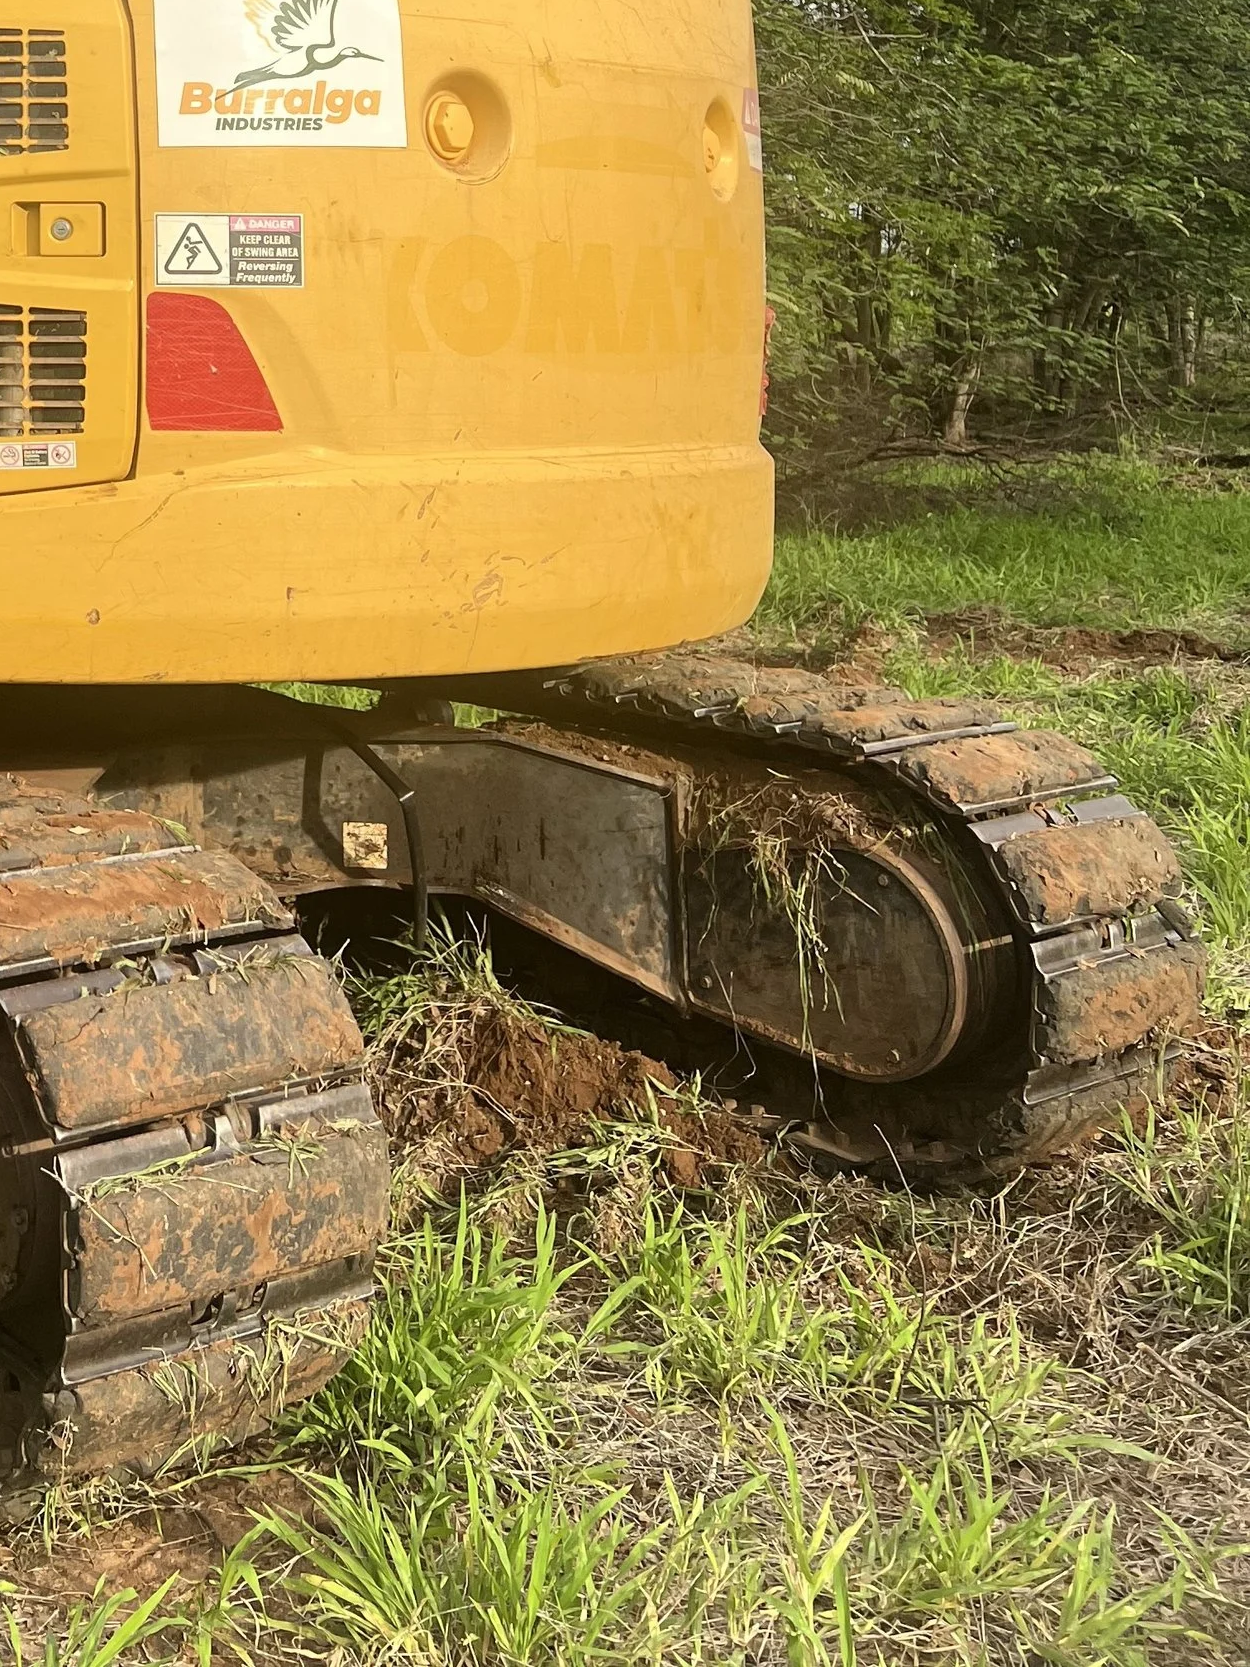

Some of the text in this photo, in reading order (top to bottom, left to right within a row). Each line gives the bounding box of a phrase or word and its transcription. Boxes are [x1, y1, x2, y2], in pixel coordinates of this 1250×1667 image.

[178, 80, 382, 124] Burralga
[215, 117, 324, 131] INDUSTRIES
[248, 219, 295, 229] DANGER
[239, 235, 291, 245] KEEP CLEAR
[231, 247, 299, 257] OF SWING AREA
[237, 261, 294, 273] Reversing
[235, 272, 297, 284] Frequently
